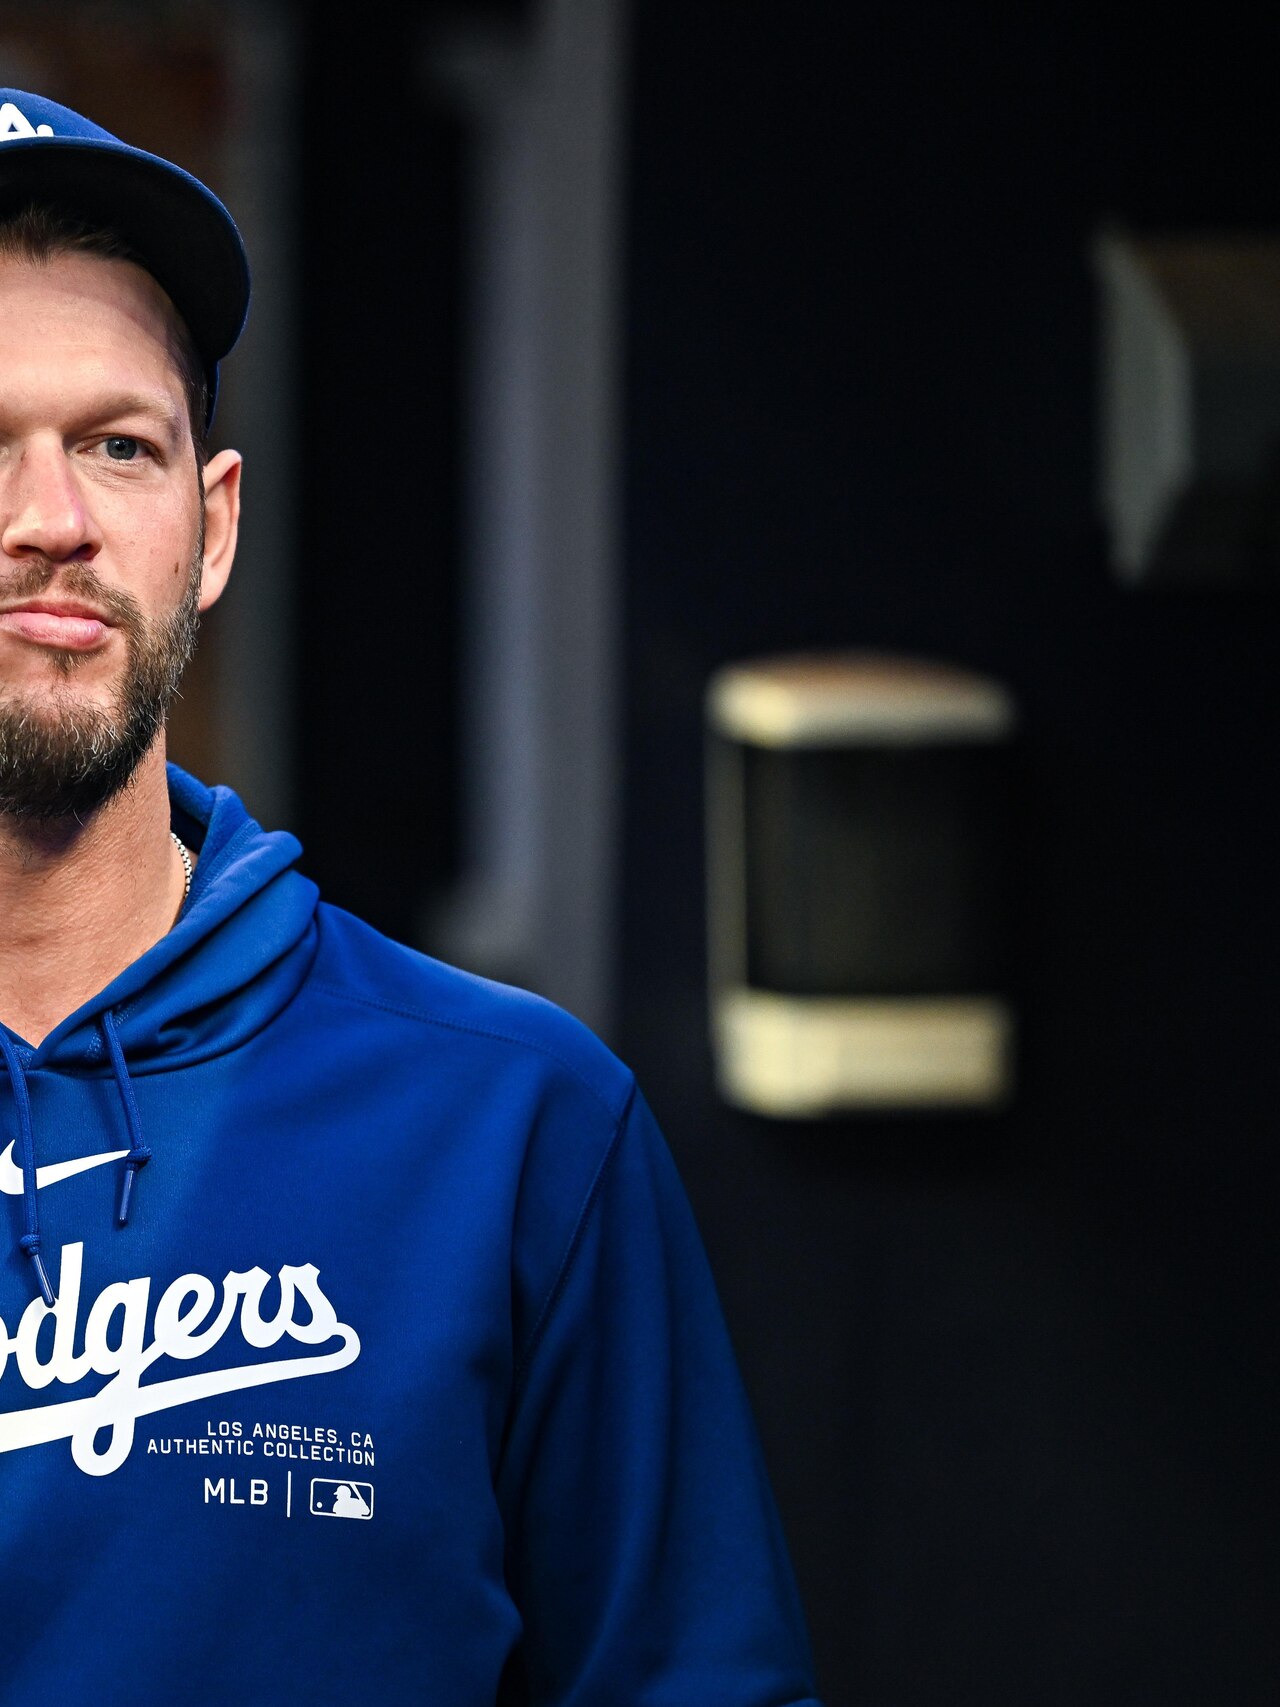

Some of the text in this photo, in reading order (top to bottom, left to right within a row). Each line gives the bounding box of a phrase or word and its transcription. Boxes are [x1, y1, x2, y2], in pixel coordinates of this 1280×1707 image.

[207, 1421, 374, 1448] LOS ANGELES, CA
[147, 1439, 375, 1466] AUTHENTIC COLLECTION
[204, 1477, 269, 1505] MLB
